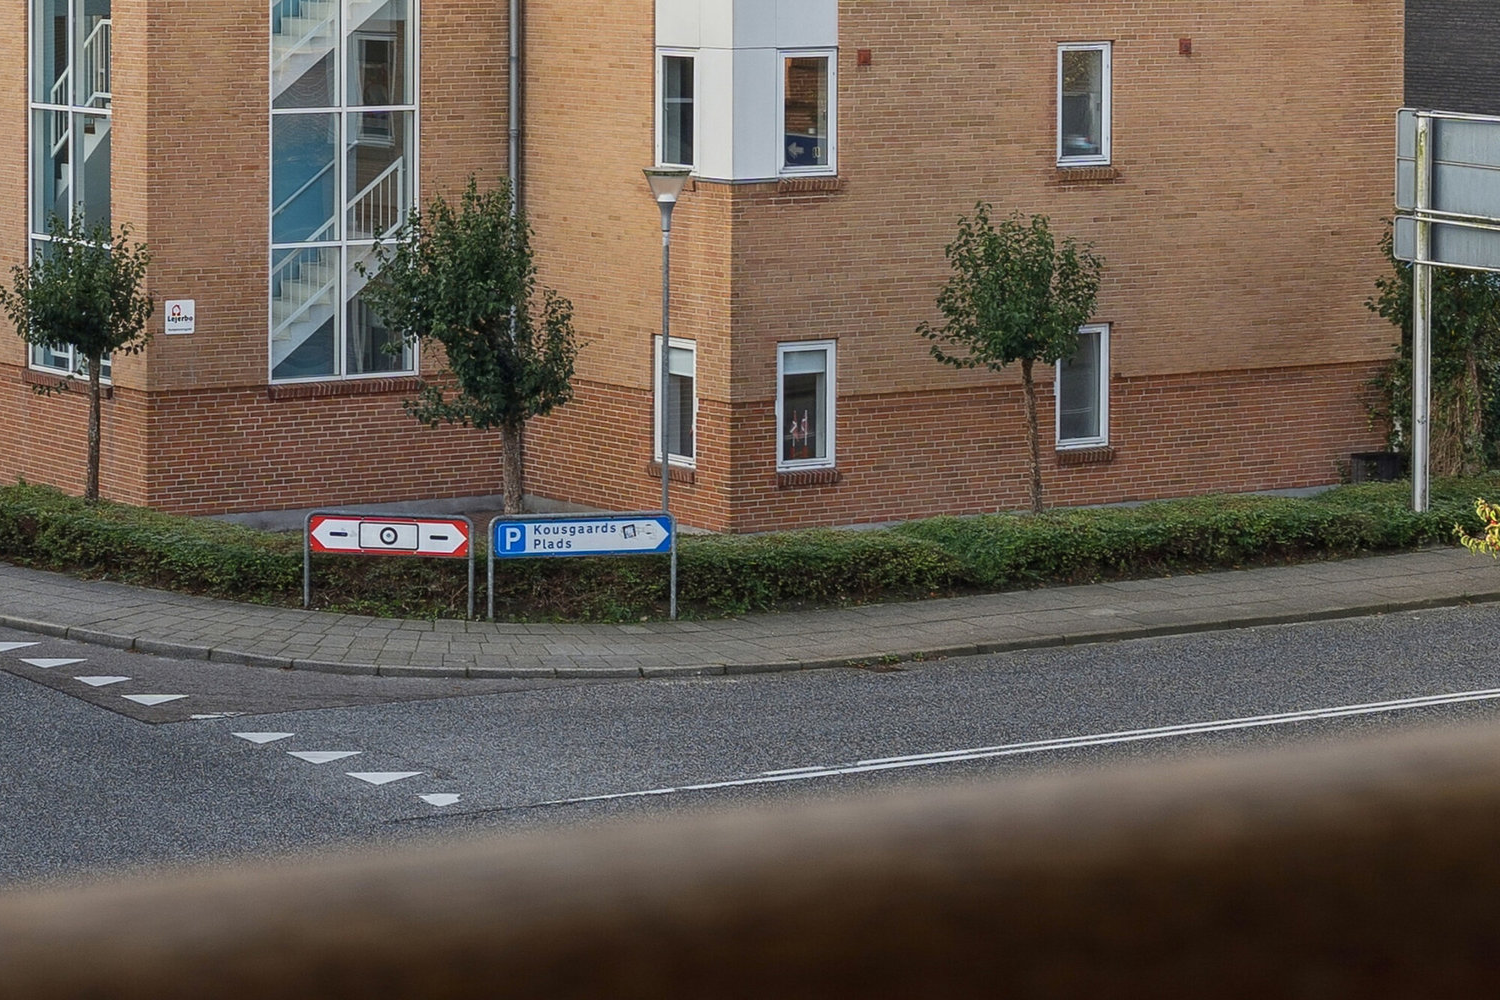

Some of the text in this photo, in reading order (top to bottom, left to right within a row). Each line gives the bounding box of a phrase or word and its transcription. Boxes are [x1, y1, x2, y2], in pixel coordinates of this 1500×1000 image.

[167, 315, 193, 323] Lejerbo
[533, 523, 617, 536] Kousgaards
[505, 527, 521, 550] P
[533, 538, 572, 549] Plads
